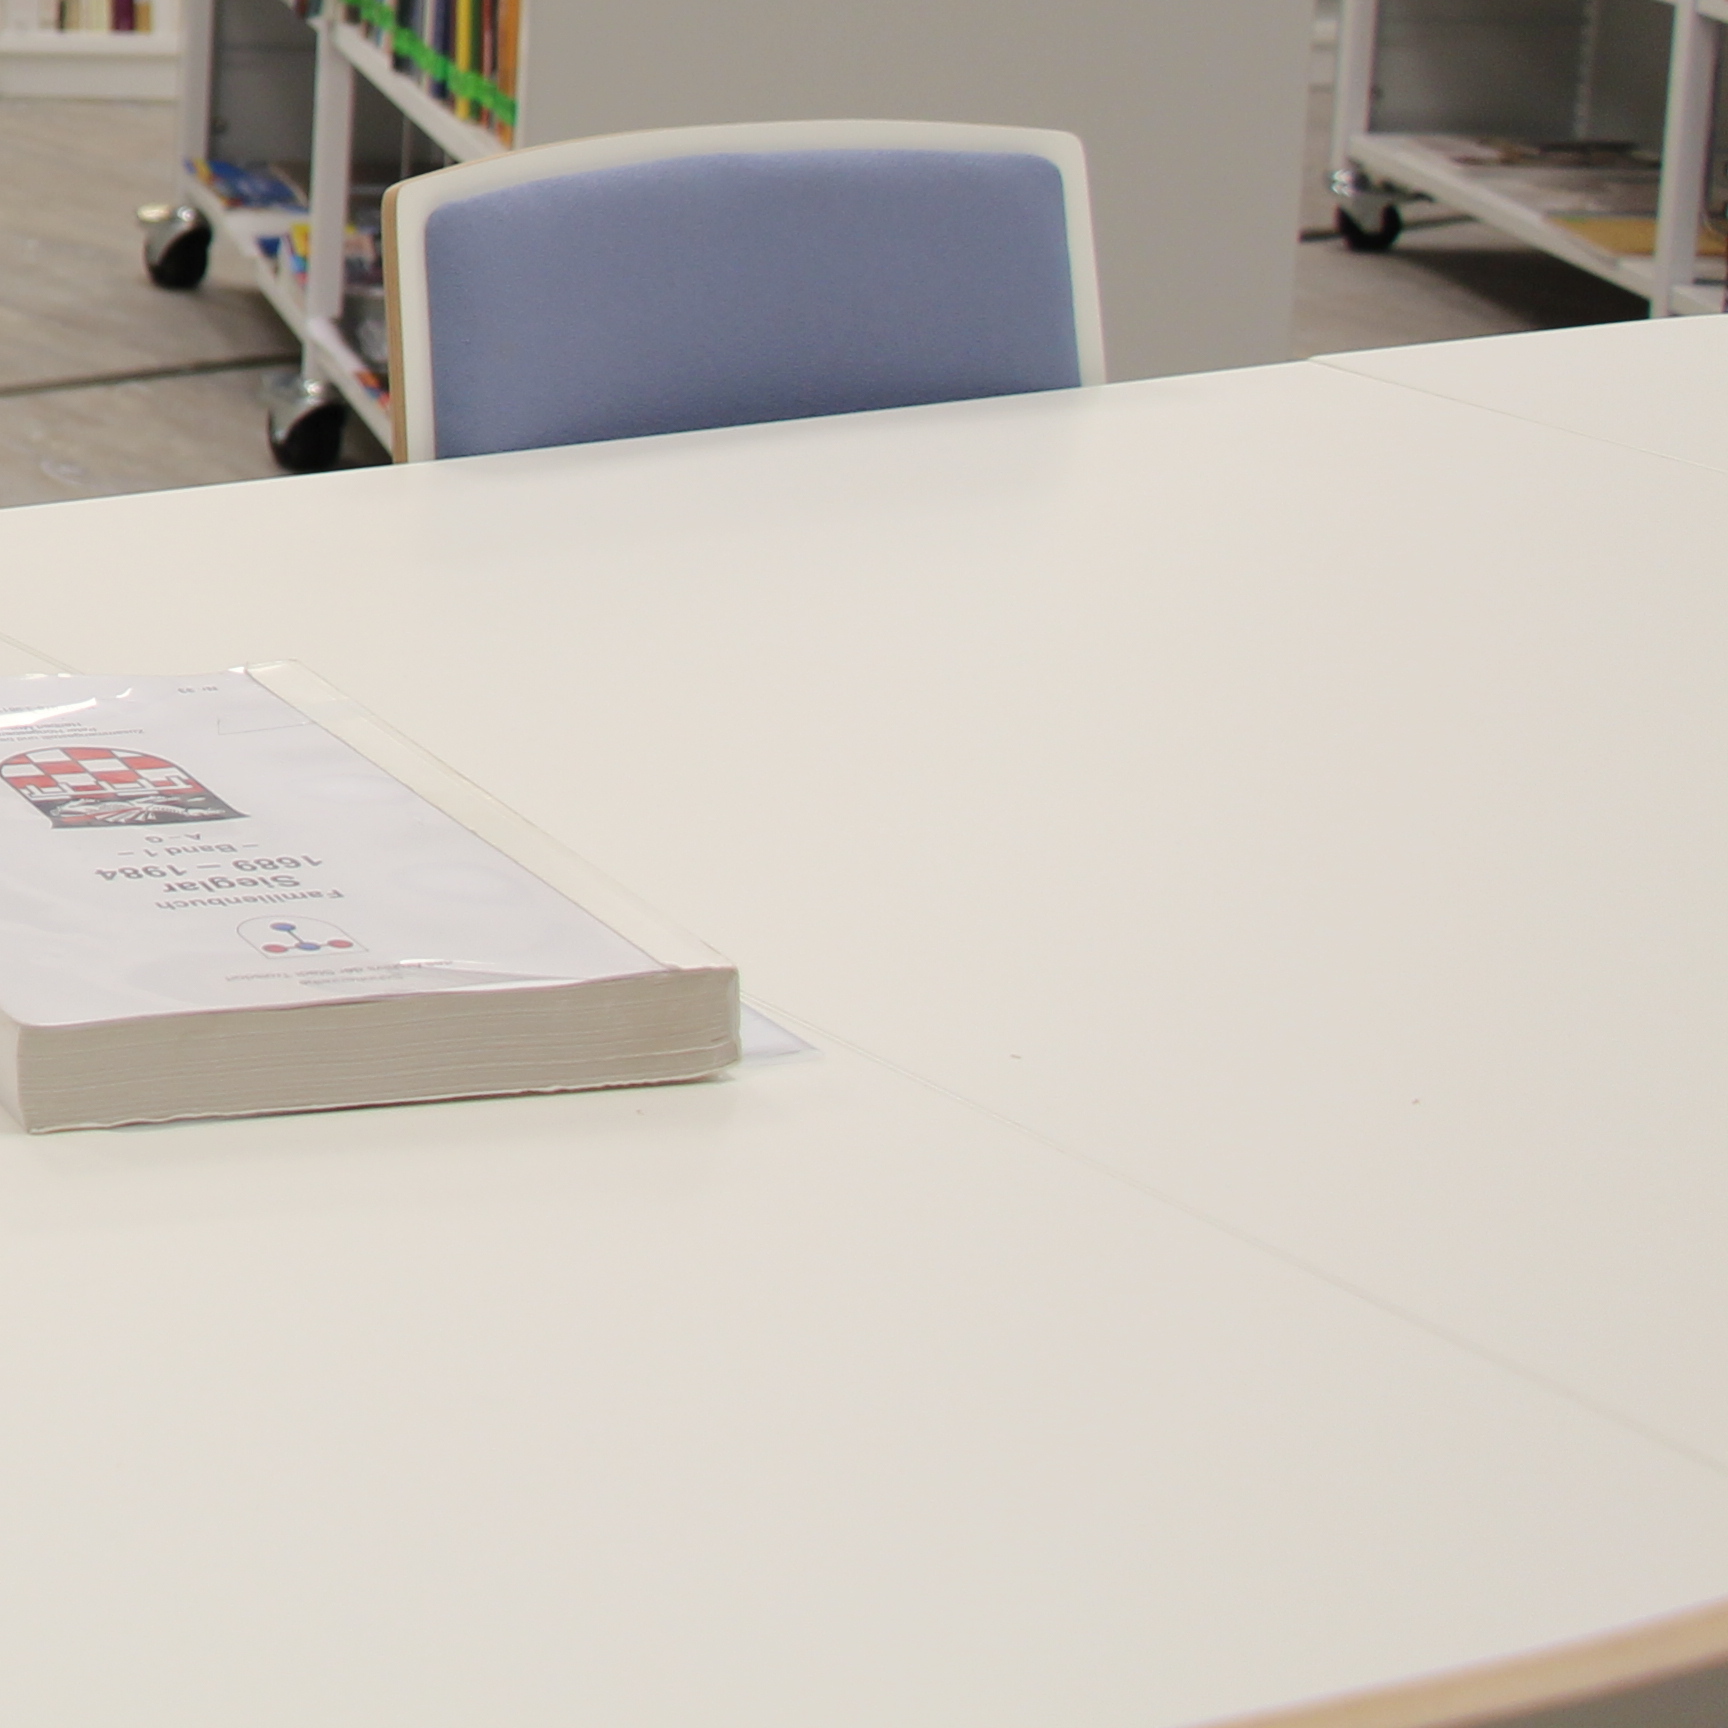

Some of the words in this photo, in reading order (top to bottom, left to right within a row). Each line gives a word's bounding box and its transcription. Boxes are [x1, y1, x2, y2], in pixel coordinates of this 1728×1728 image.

[142, 848, 159, 859] 1
[163, 843, 239, 857] Band
[94, 864, 188, 882] 1984
[230, 855, 323, 873] 1689
[162, 875, 301, 894] Sieglar
[154, 889, 345, 911] Familienbuch
